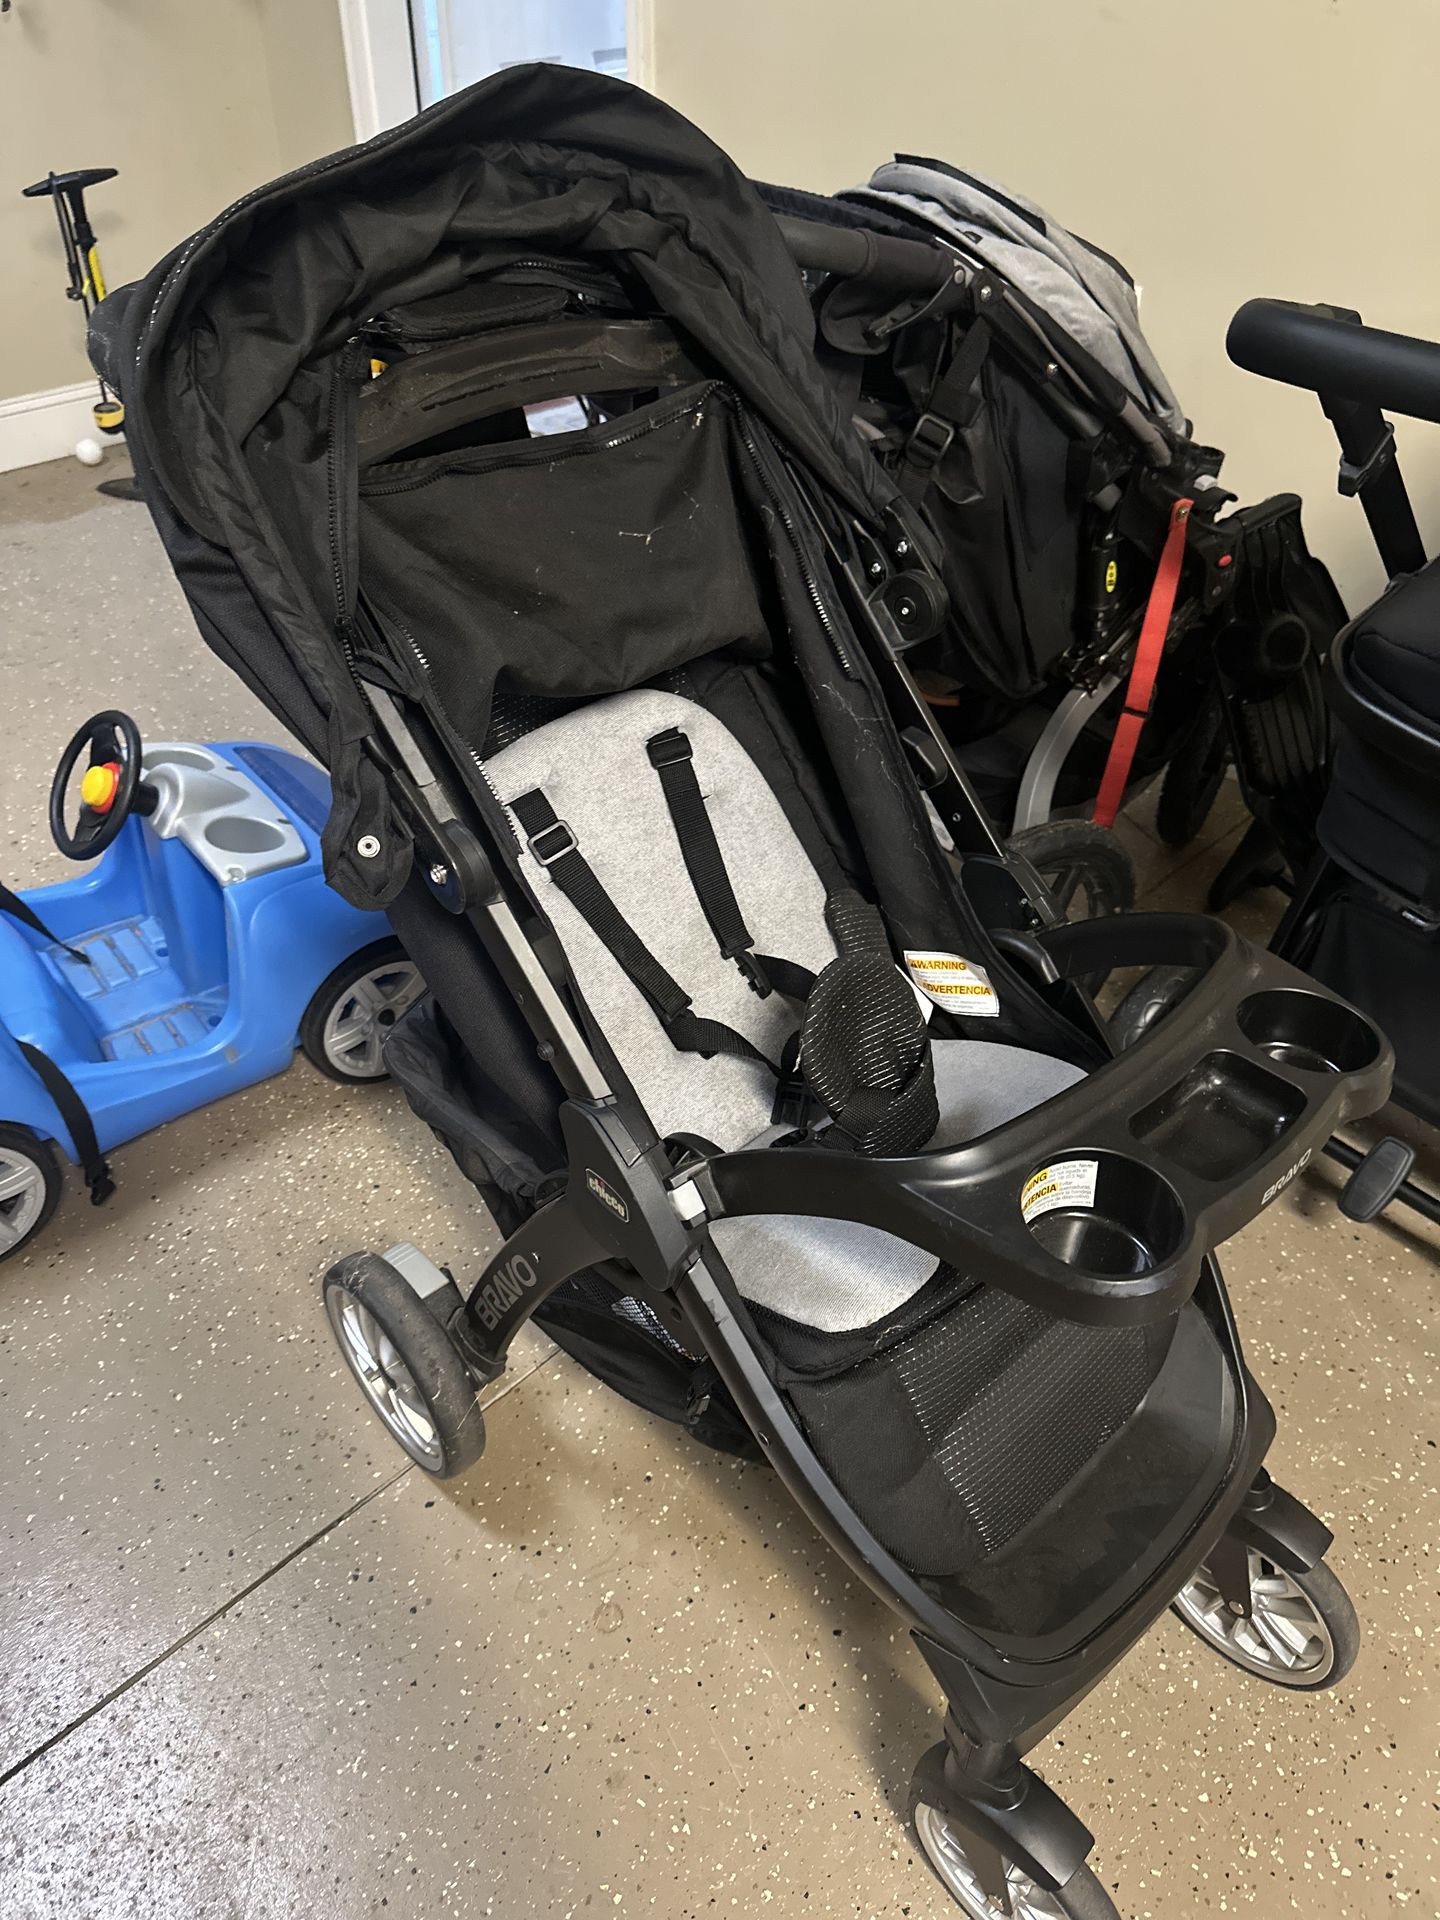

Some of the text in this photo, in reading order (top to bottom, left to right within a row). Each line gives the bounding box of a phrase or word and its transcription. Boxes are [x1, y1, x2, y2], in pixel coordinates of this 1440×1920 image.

[917, 960, 967, 970] WARNING
[588, 1176, 625, 1217] chicco
[1261, 1147, 1312, 1205] BRAVO
[474, 1254, 537, 1331] BRAVO
